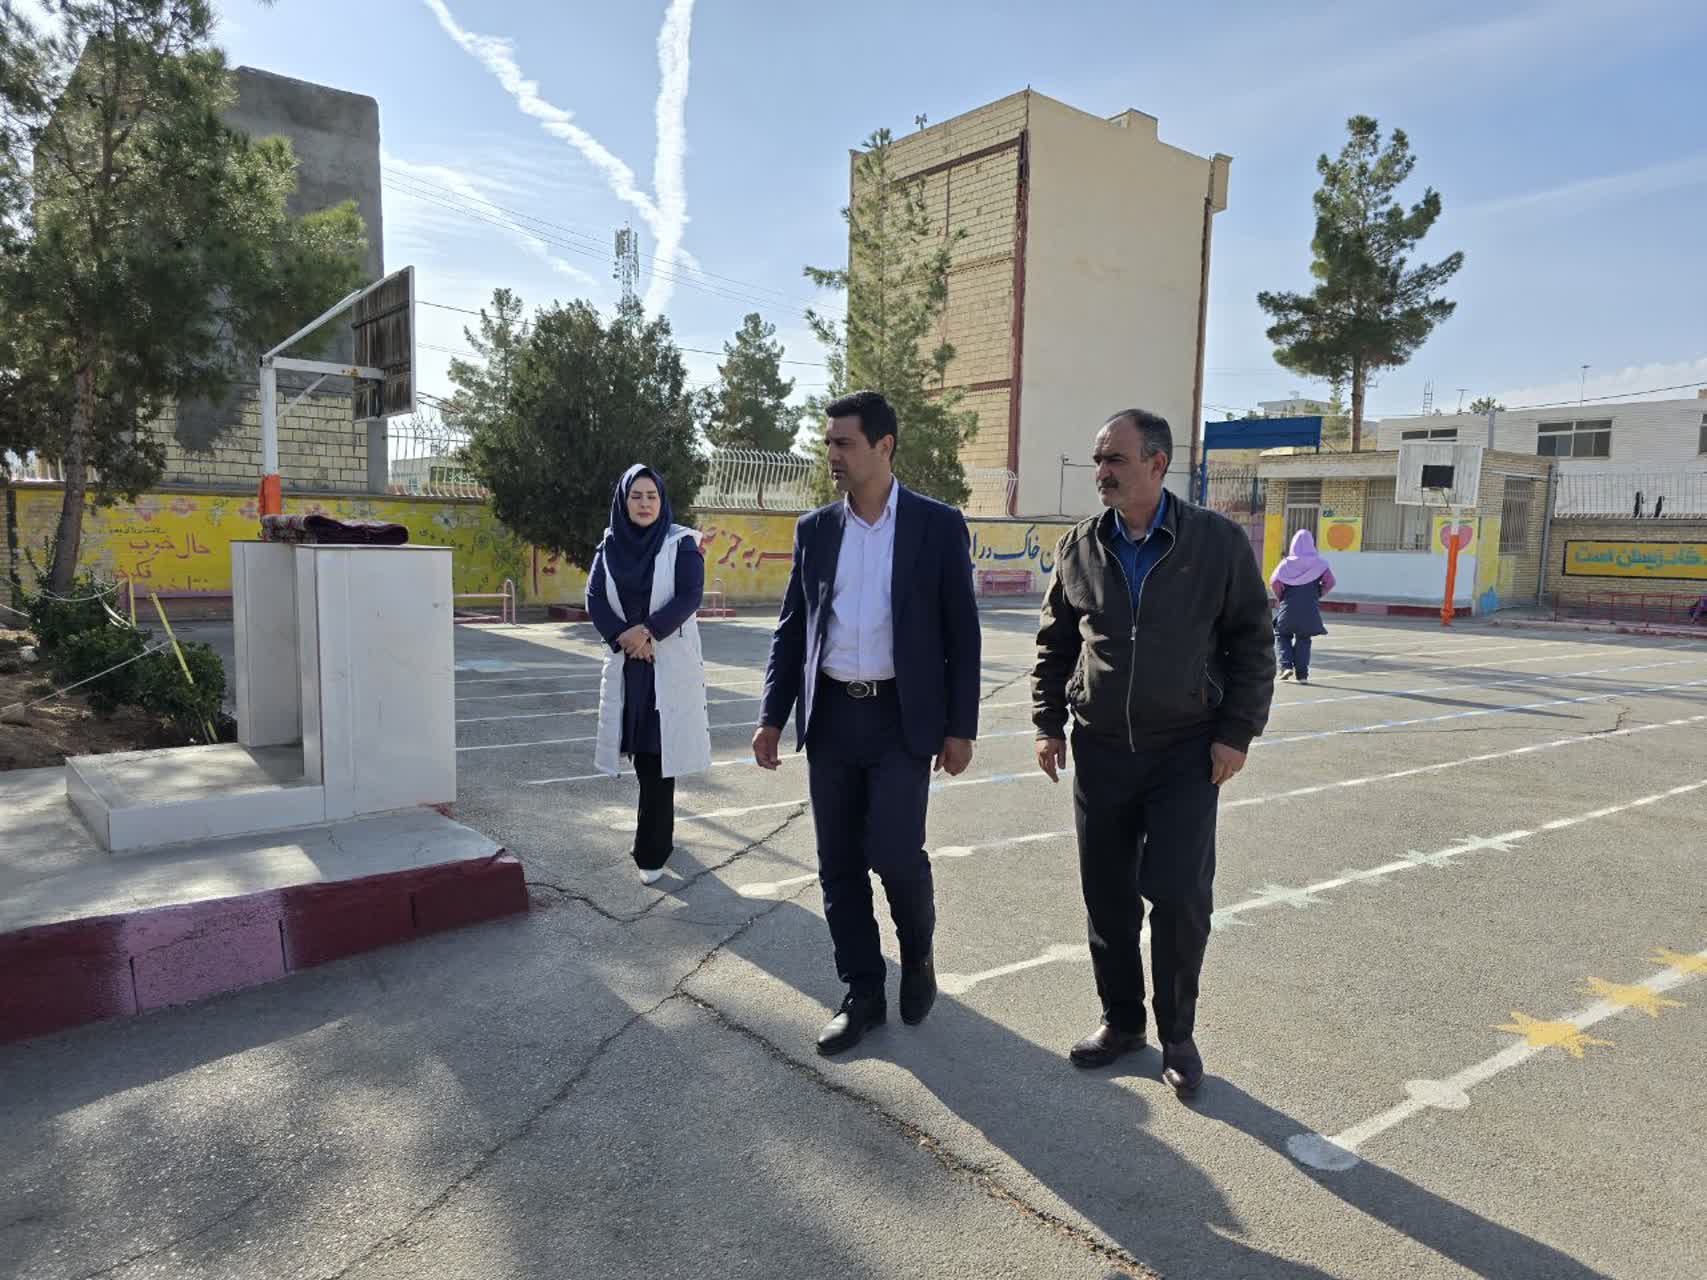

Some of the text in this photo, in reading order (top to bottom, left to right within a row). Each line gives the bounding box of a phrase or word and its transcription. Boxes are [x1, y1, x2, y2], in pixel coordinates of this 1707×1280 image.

[129, 532, 210, 559] حال خوب
[993, 523, 1041, 560] خاک
